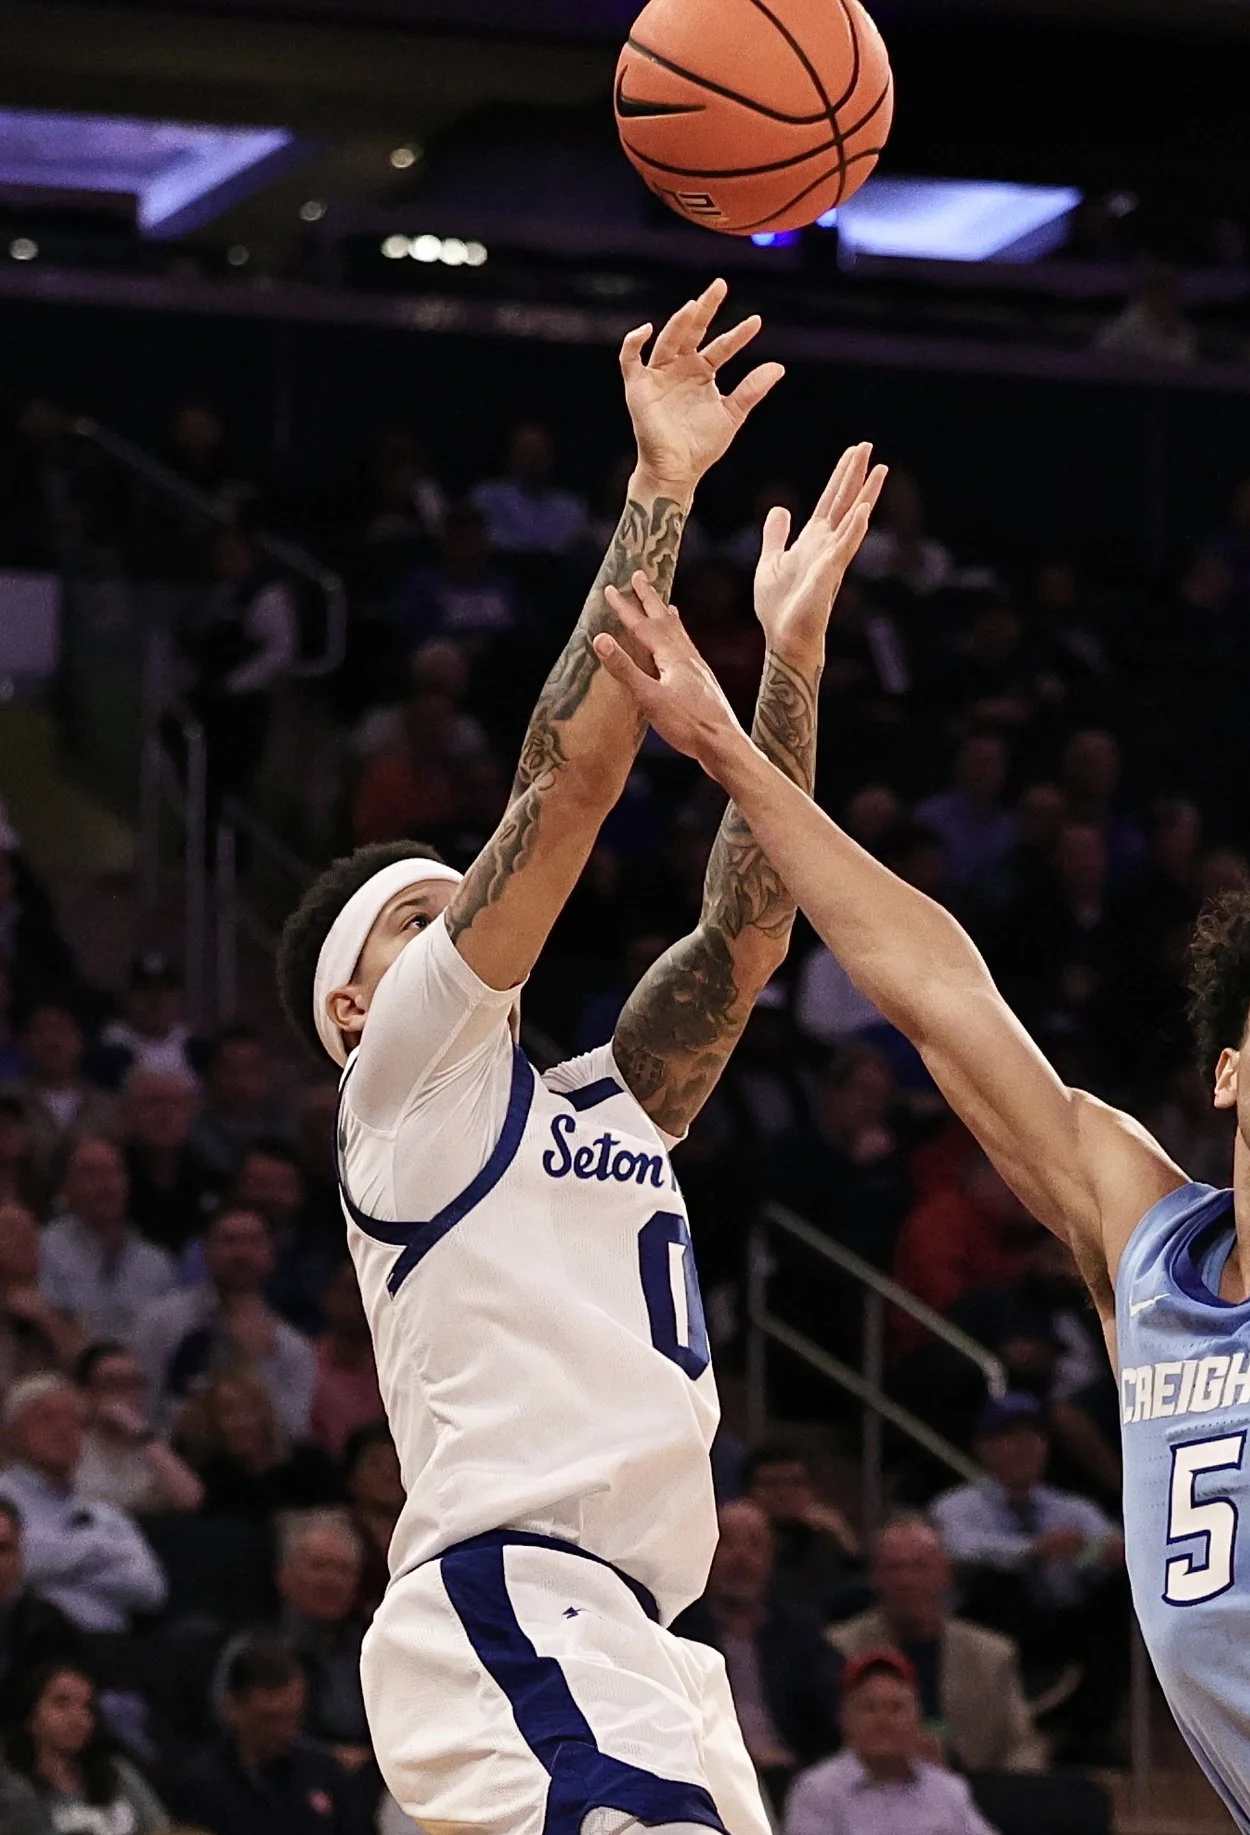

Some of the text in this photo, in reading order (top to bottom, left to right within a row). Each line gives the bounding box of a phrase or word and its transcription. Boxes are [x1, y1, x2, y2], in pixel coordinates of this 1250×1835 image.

[542, 1113, 665, 1188] Seton
[637, 1210, 711, 1382] 0
[1161, 1428, 1248, 1607] 5
